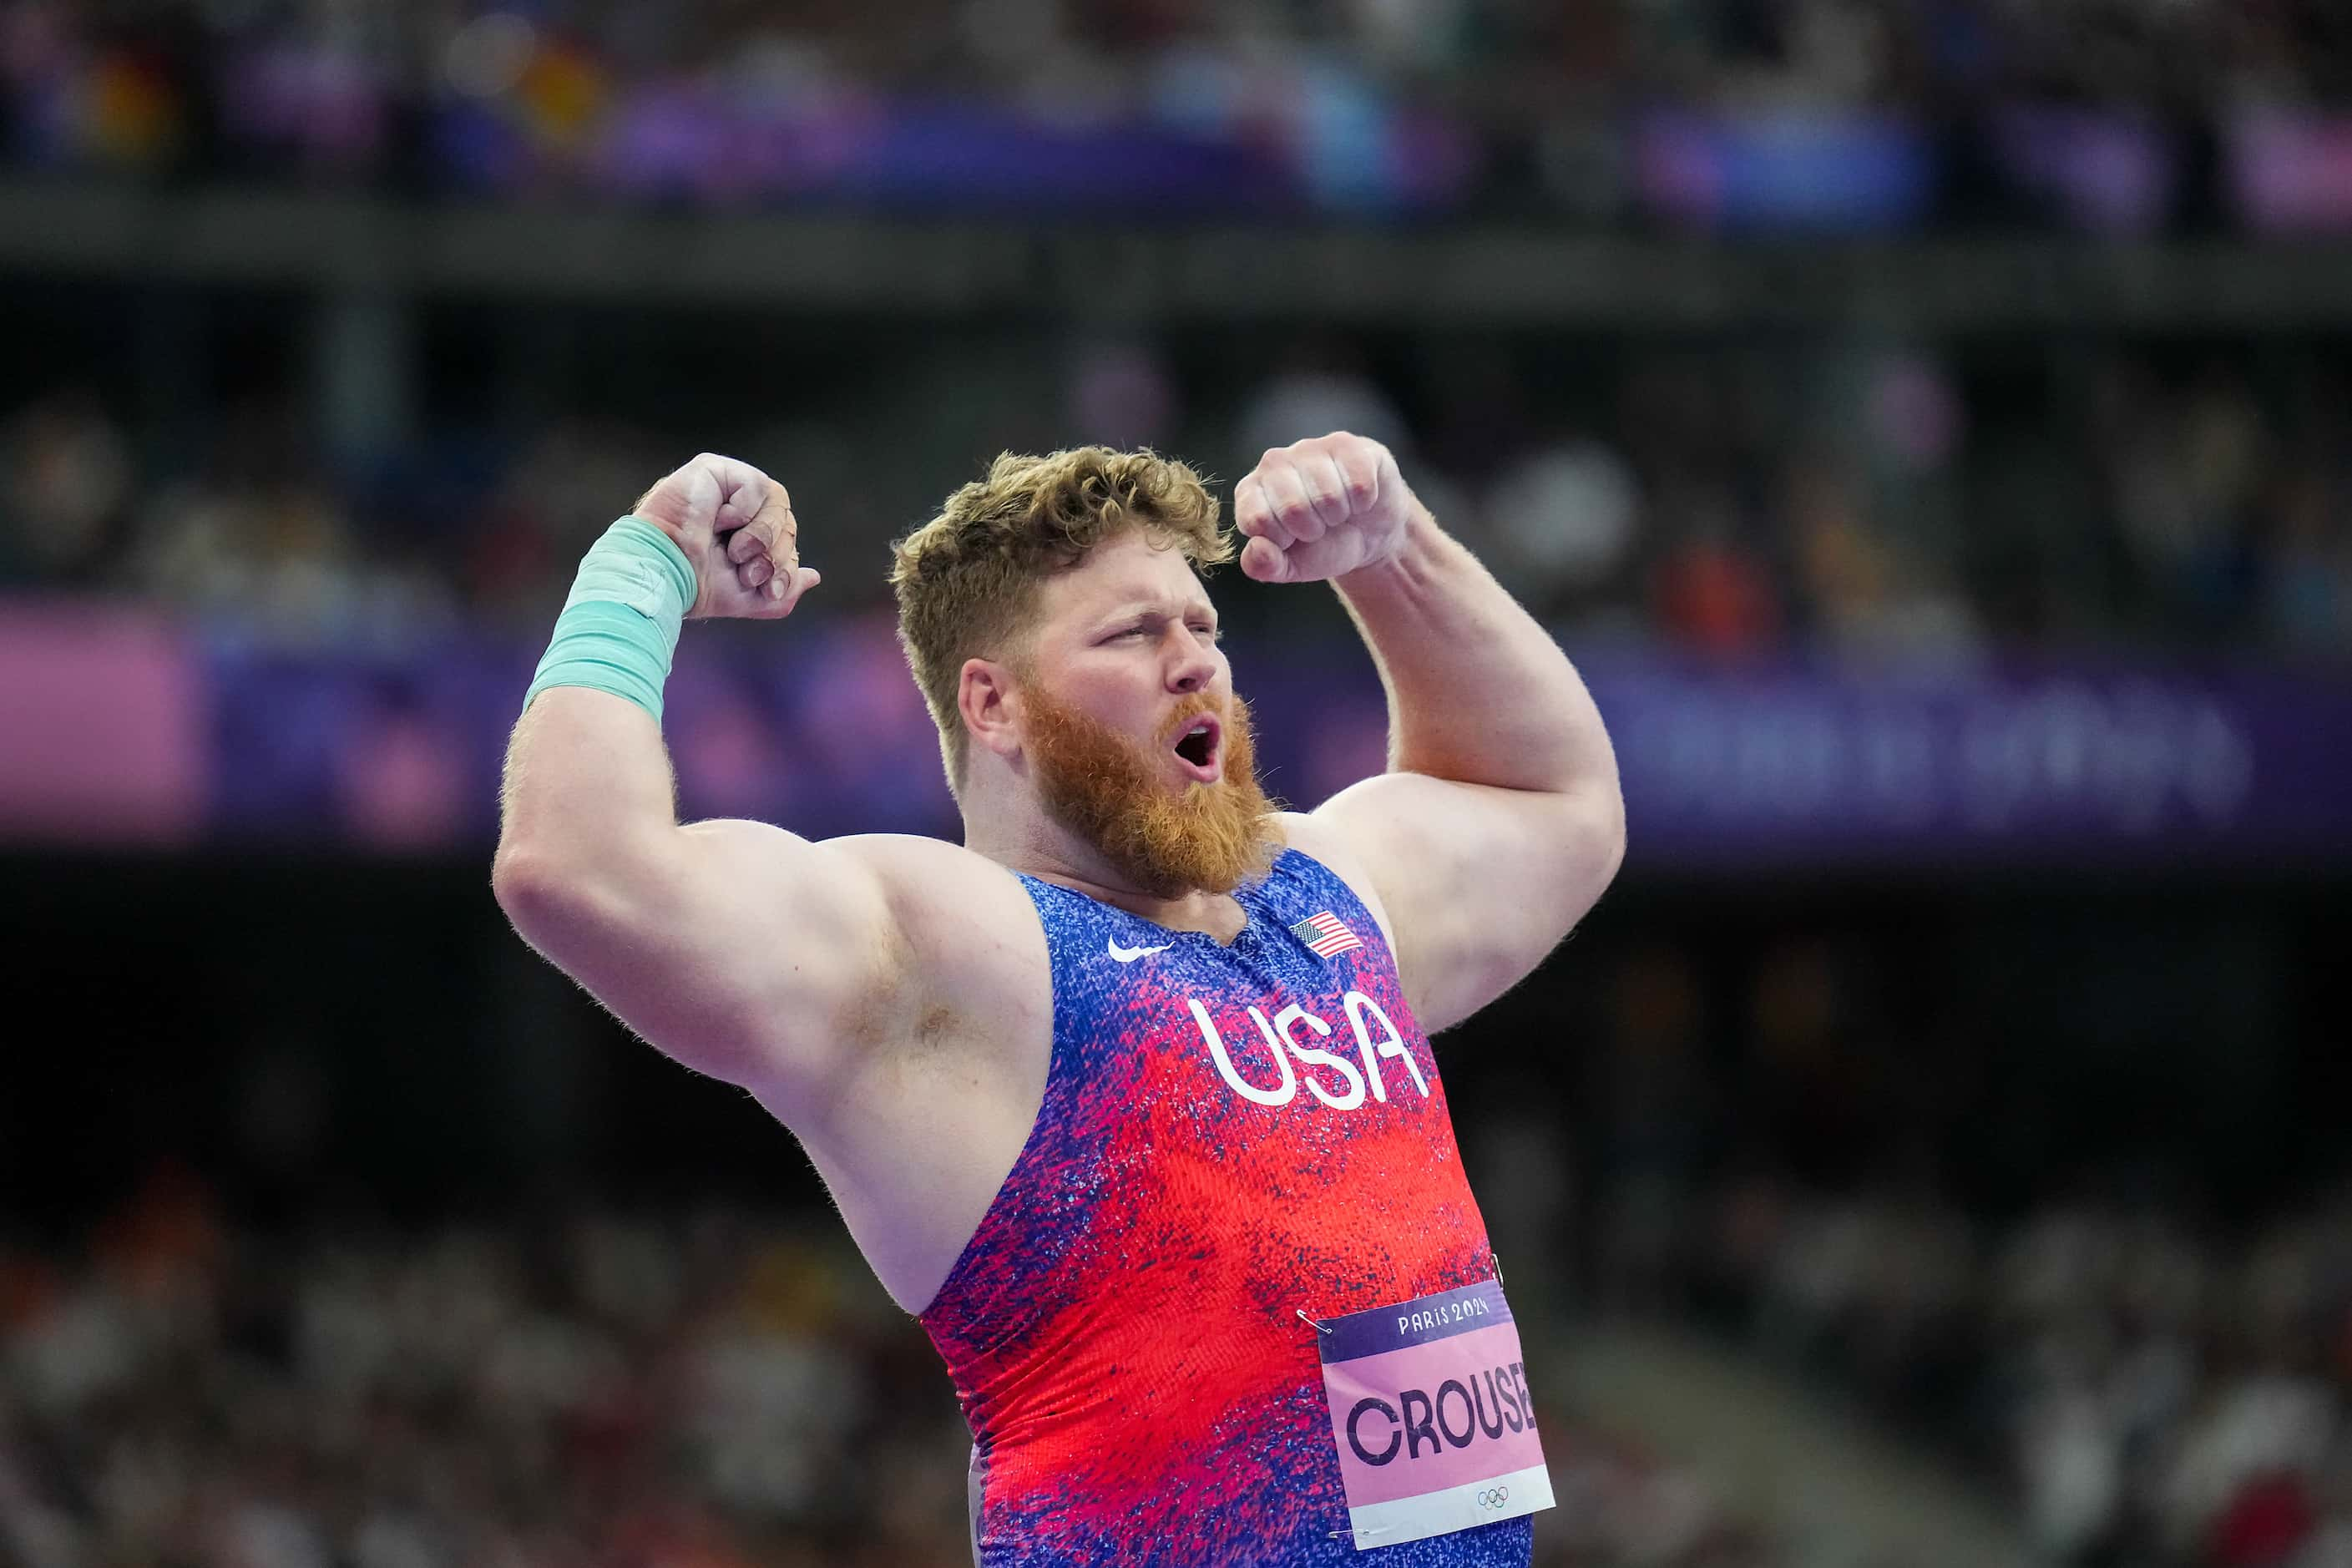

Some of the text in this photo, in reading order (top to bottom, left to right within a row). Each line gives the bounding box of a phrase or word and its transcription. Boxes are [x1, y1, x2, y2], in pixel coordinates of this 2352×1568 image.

[1188, 991, 1429, 1110] USA
[1451, 1297, 1490, 1322] 2024
[1347, 1362, 1535, 1466] CROUSE
